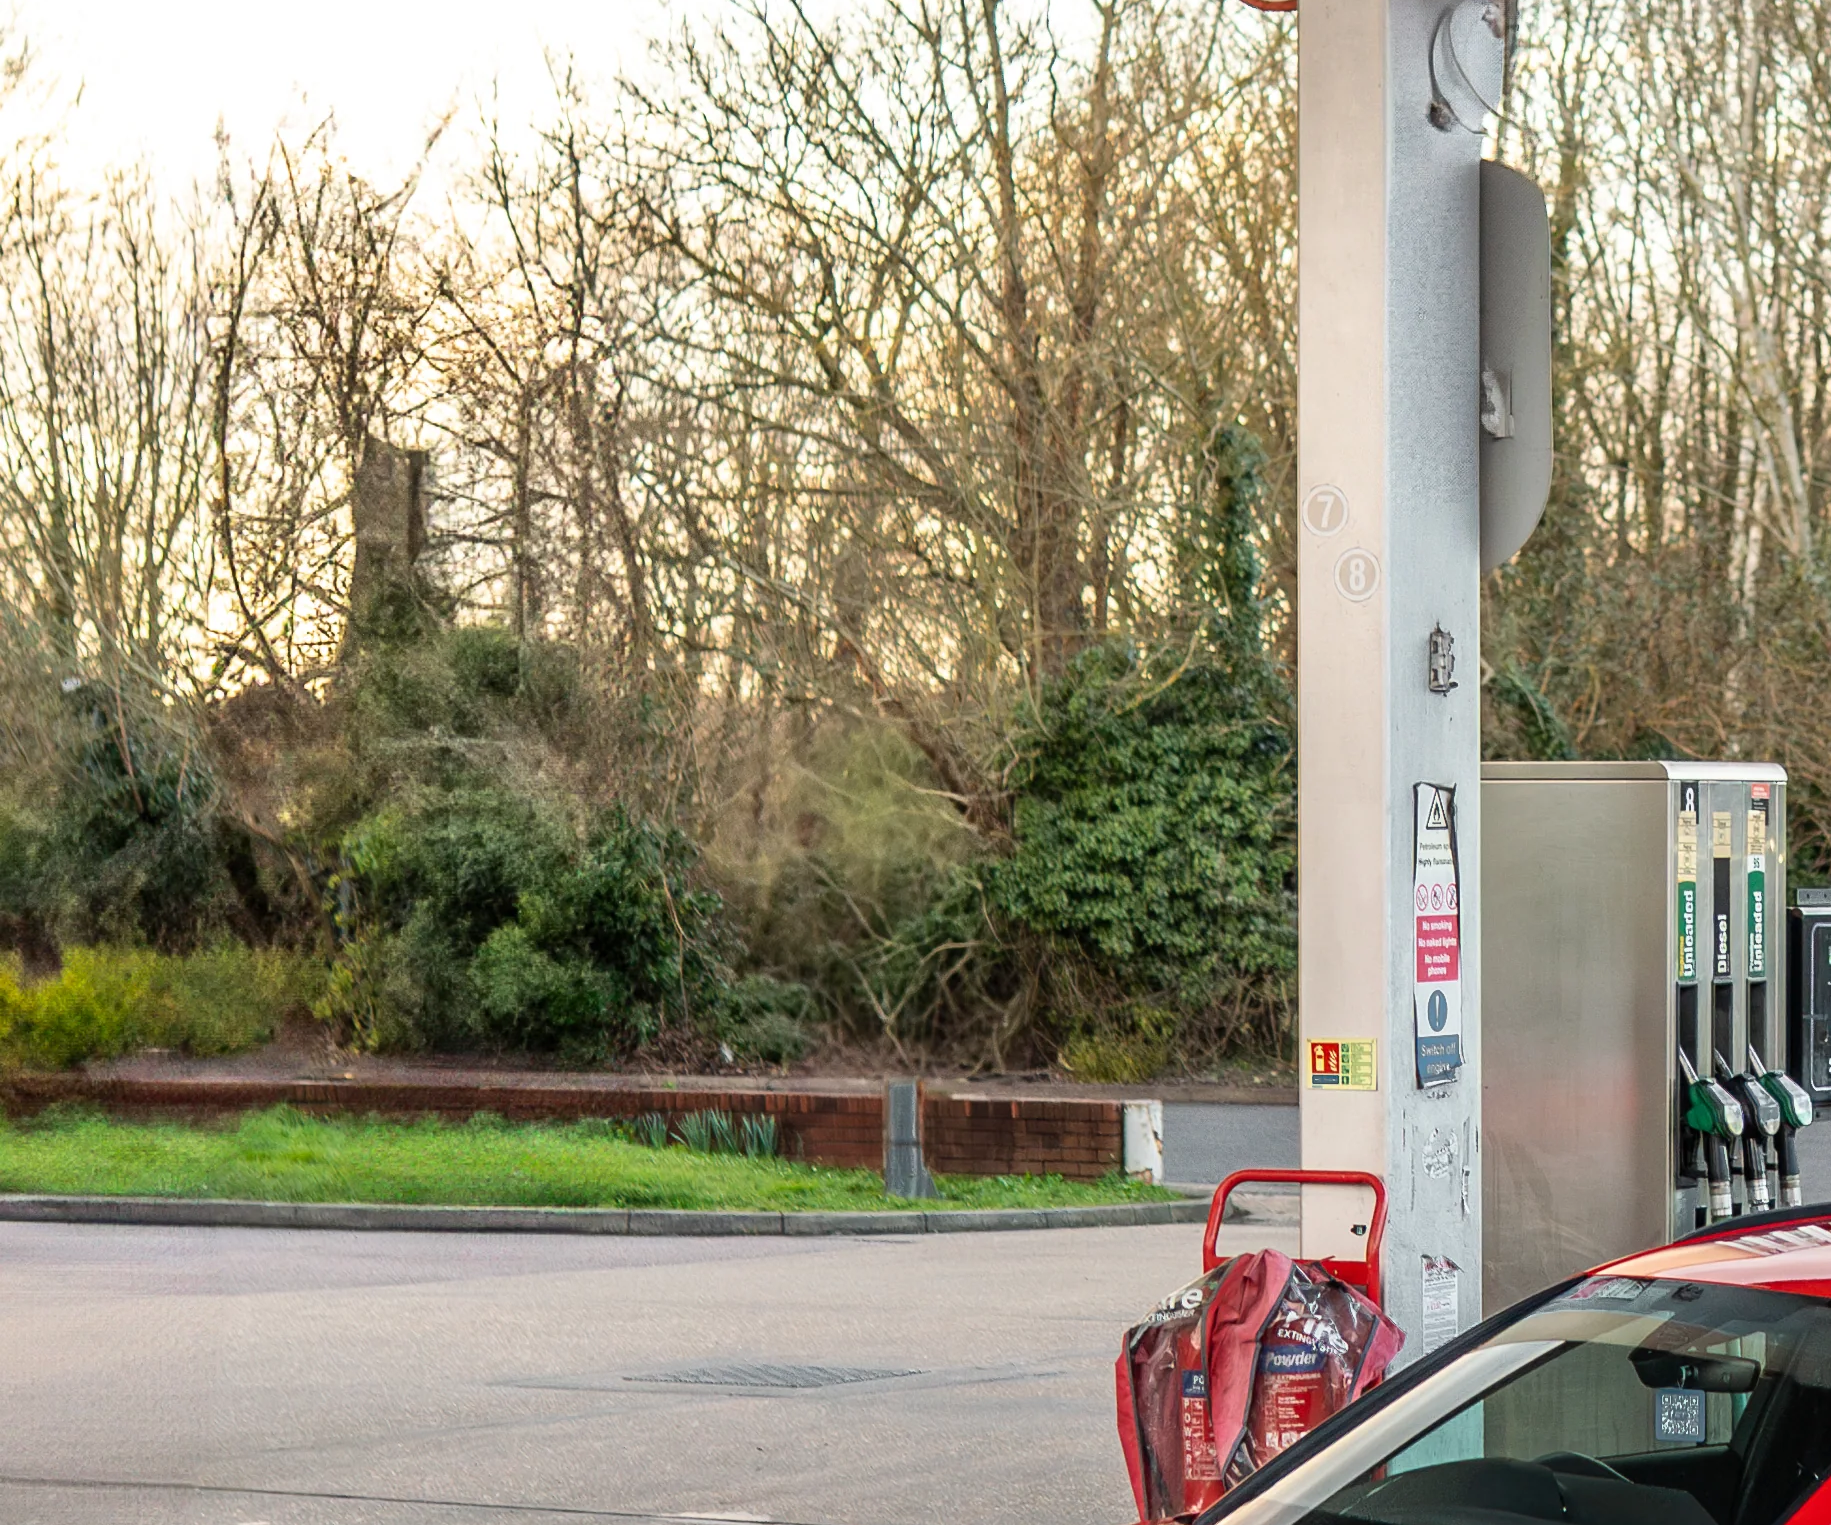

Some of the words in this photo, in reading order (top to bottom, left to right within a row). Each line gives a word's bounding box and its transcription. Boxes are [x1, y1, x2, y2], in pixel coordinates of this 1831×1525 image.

[1316, 495, 1335, 528] 7
[1349, 557, 1366, 591] 8
[1422, 921, 1430, 931] No
[1683, 890, 1694, 977] Unleaded
[1753, 891, 1763, 973] Unleaded
[1717, 914, 1728, 973] Diesel
[1421, 1044, 1445, 1057] Switch
